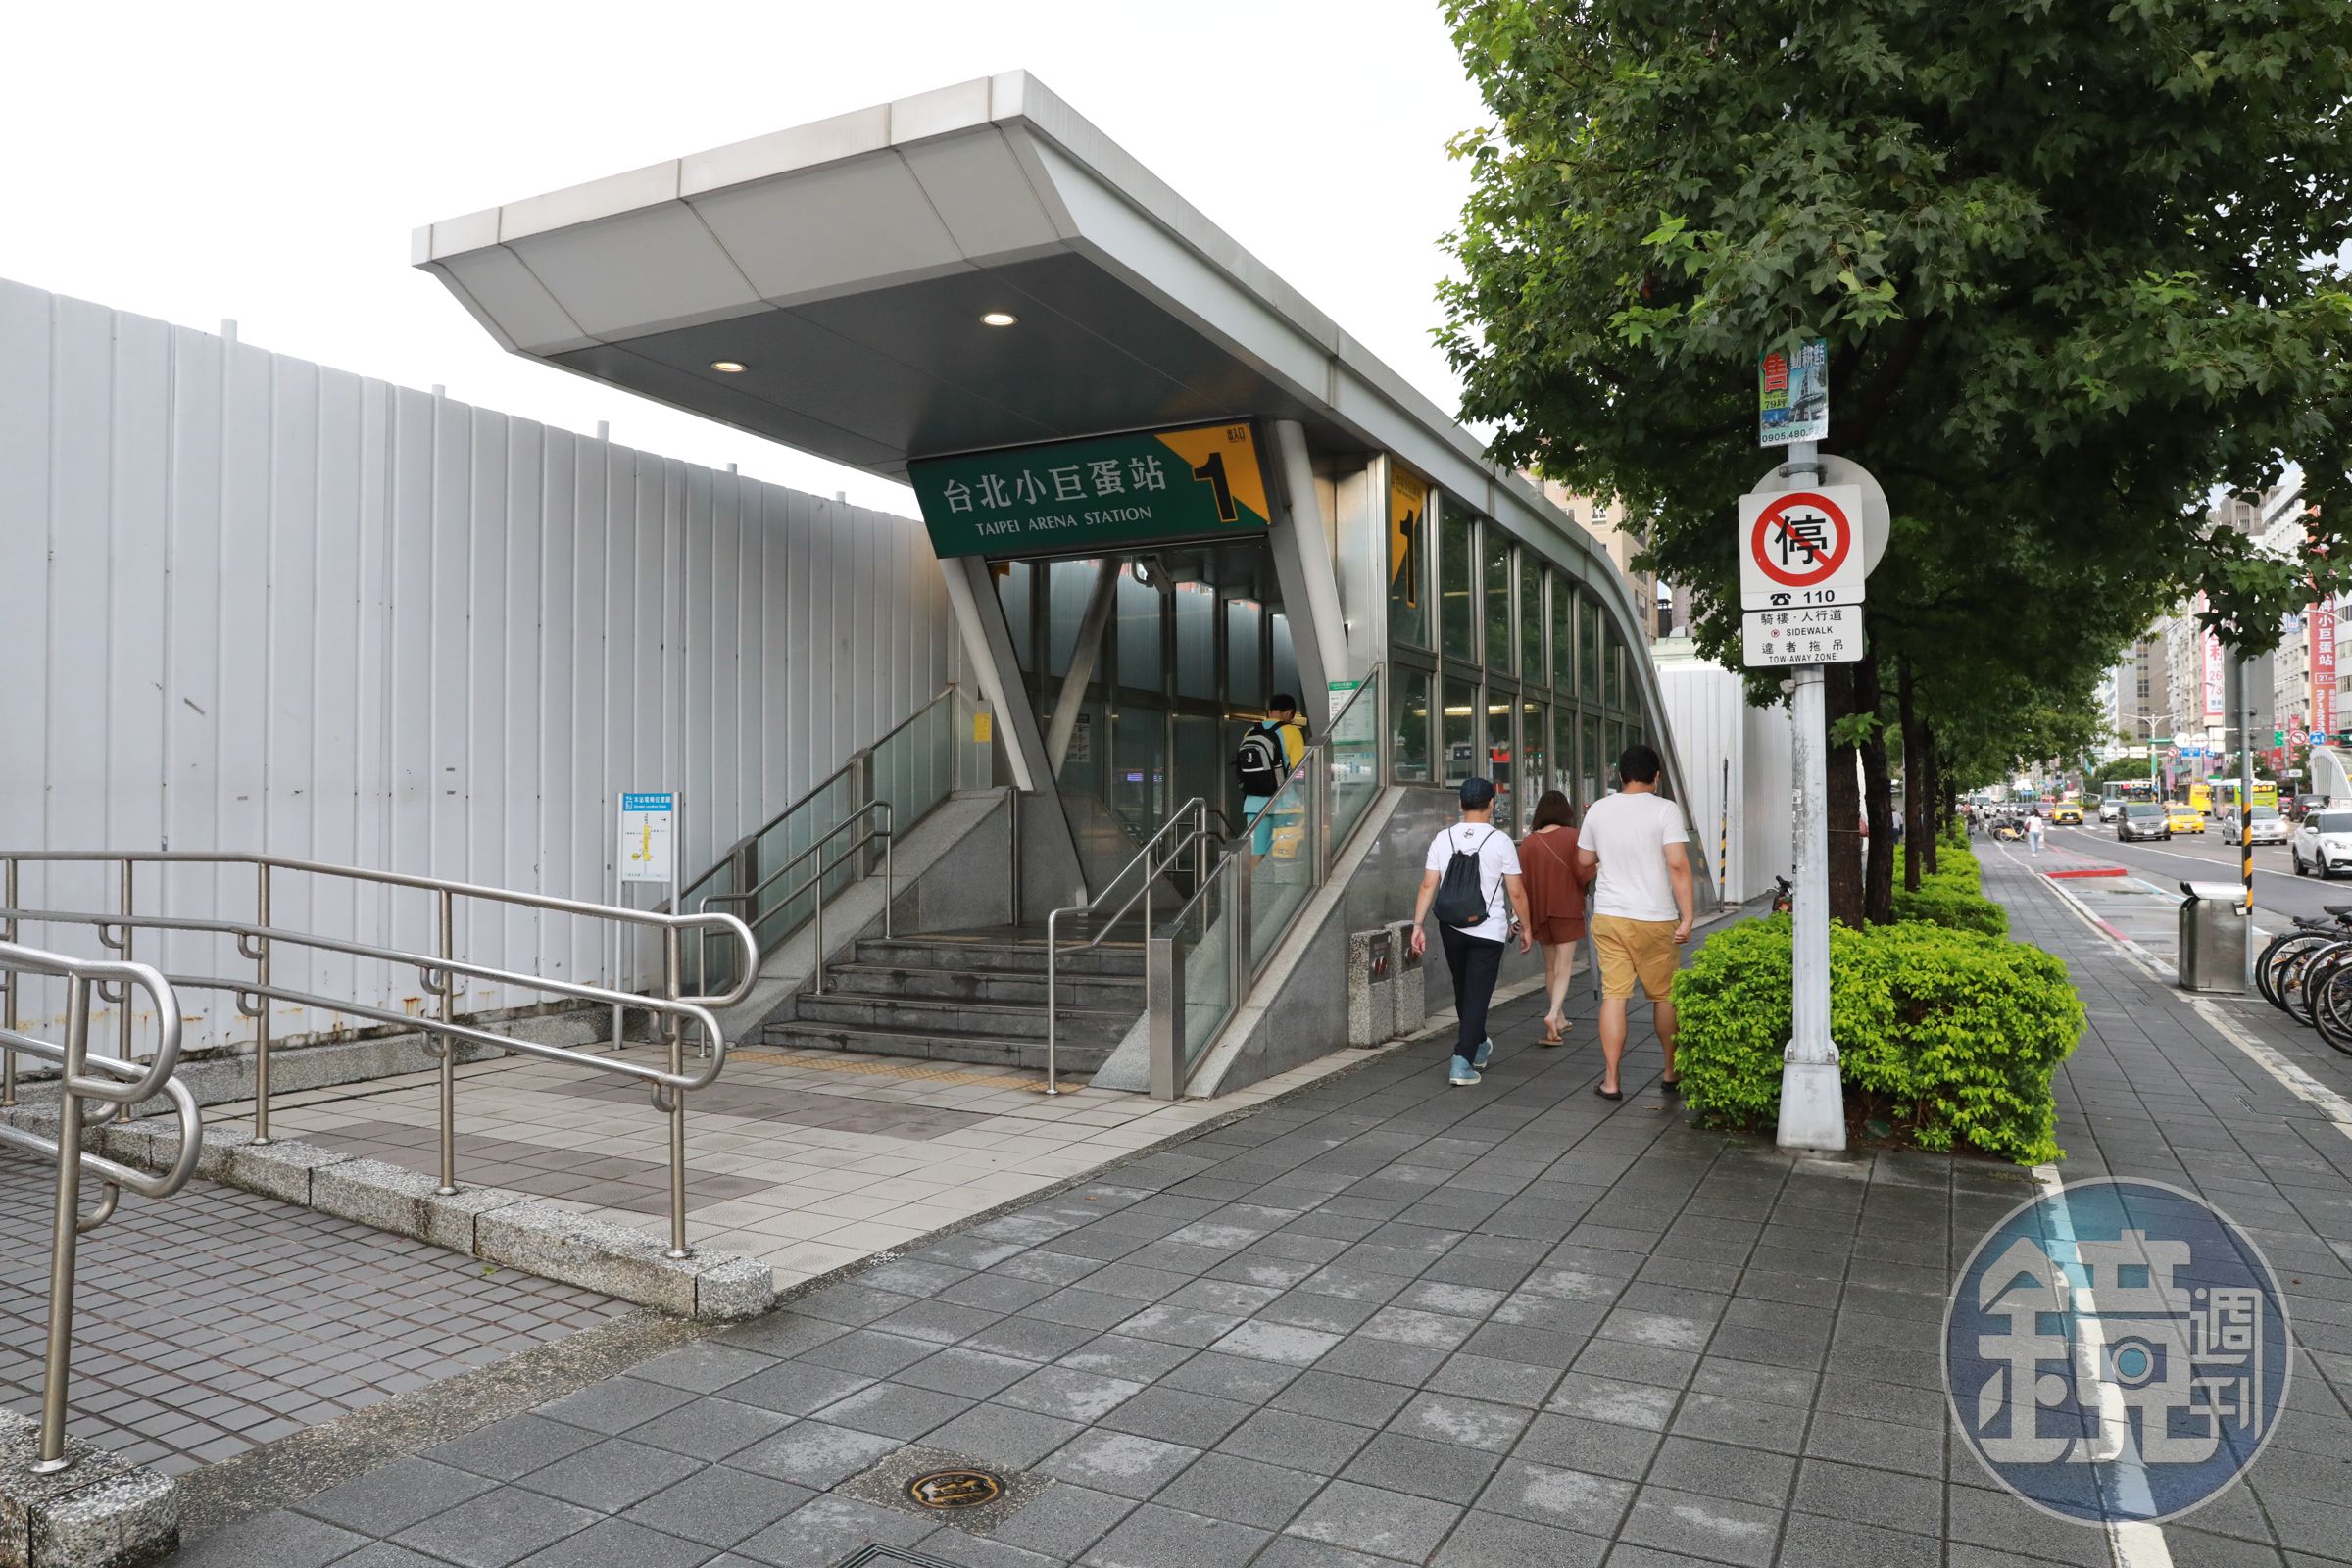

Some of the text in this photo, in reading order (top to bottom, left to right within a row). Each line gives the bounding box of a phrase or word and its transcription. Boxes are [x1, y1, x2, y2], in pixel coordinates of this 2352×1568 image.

[1762, 427, 1821, 443] 0905.480.
[943, 455, 1167, 514] 台北小巨蛋站
[1192, 452, 1239, 522] 1
[975, 506, 1152, 536] TAIPEI ARENA STATION
[1775, 514, 1828, 565] 停
[1803, 590, 1835, 604] 110
[1786, 626, 1833, 636] SIDEWALK
[1762, 639, 1843, 654] 違者拖吊
[1769, 653, 1837, 663] TOW-AWAY ZONE
